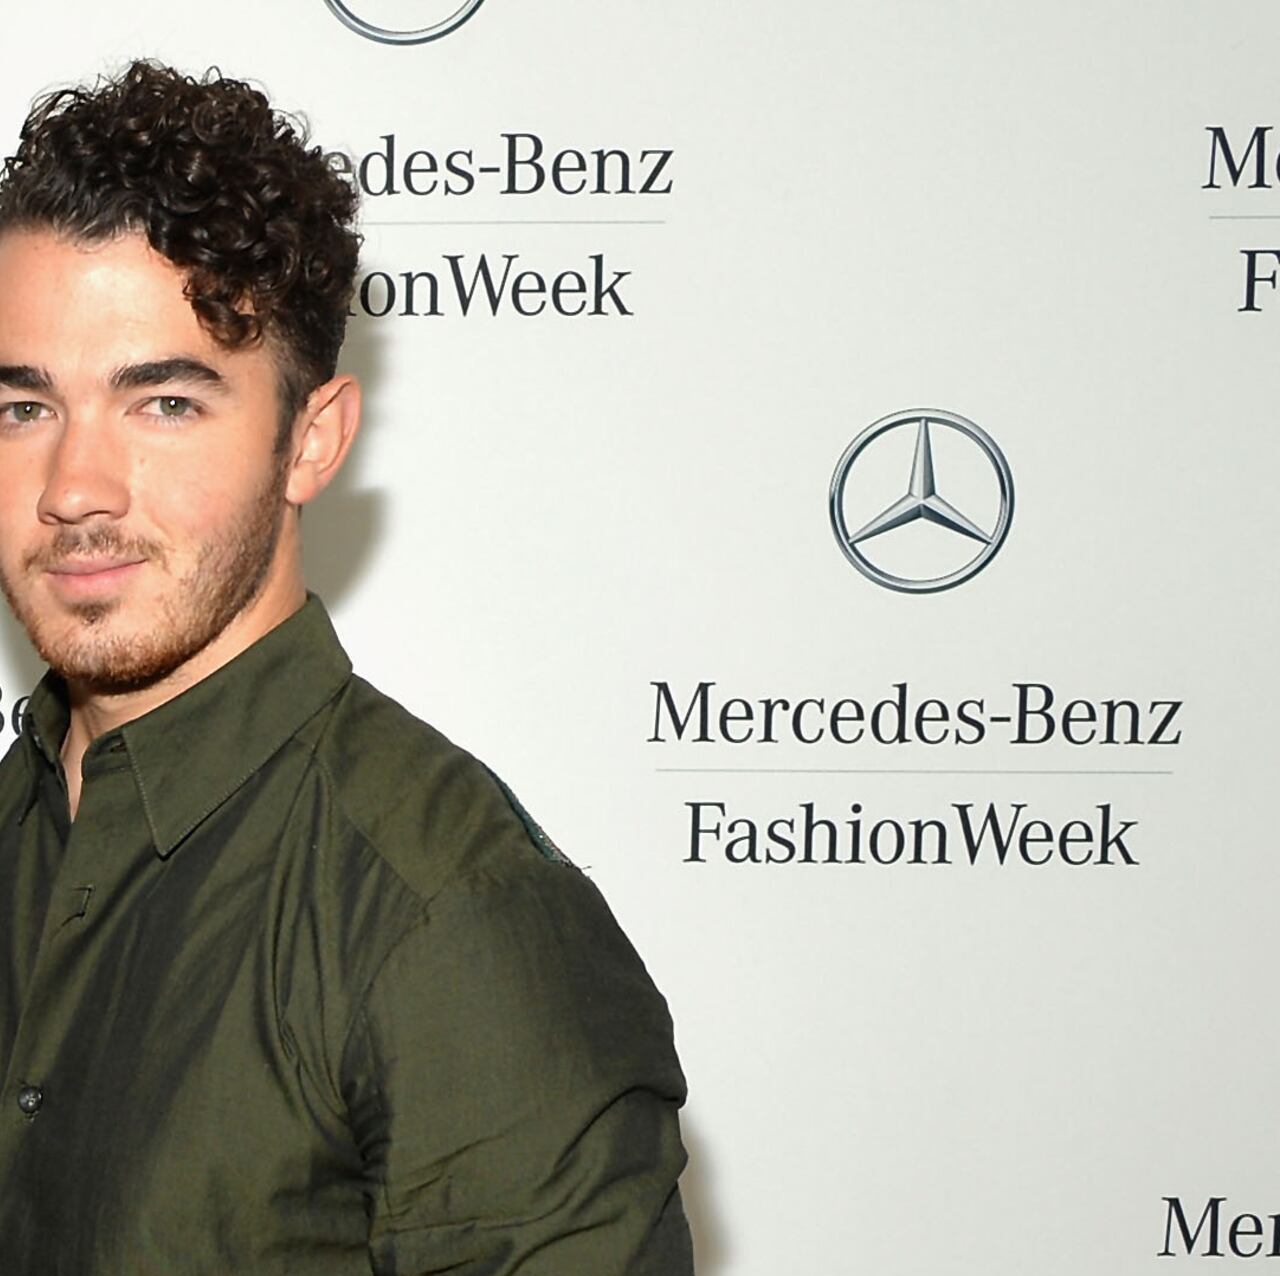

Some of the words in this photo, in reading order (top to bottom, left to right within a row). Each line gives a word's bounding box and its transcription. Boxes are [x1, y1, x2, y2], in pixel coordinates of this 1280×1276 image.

[347, 253, 634, 318] onWeek
[646, 681, 1184, 746] Mercedes-Benz
[683, 801, 1140, 866] FashionWeek
